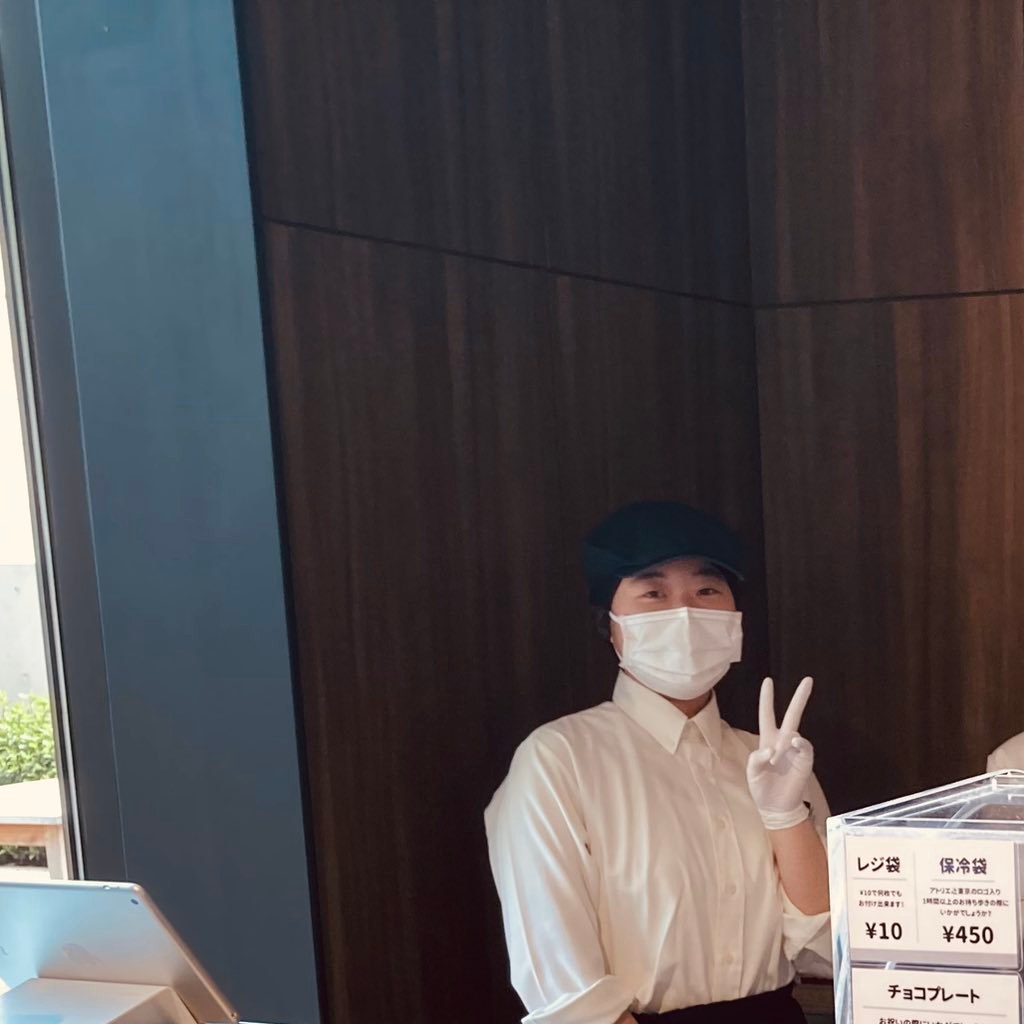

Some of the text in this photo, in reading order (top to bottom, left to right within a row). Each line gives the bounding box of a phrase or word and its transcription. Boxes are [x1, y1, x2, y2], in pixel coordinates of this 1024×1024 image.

[857, 857, 900, 873] レジ袋
[940, 858, 987, 874] 保冷袋
[940, 909, 992, 917] いかがでしょうか?
[865, 922, 902, 940] ¥10
[943, 926, 994, 944] ¥450
[888, 985, 980, 1004] チョコプレート
